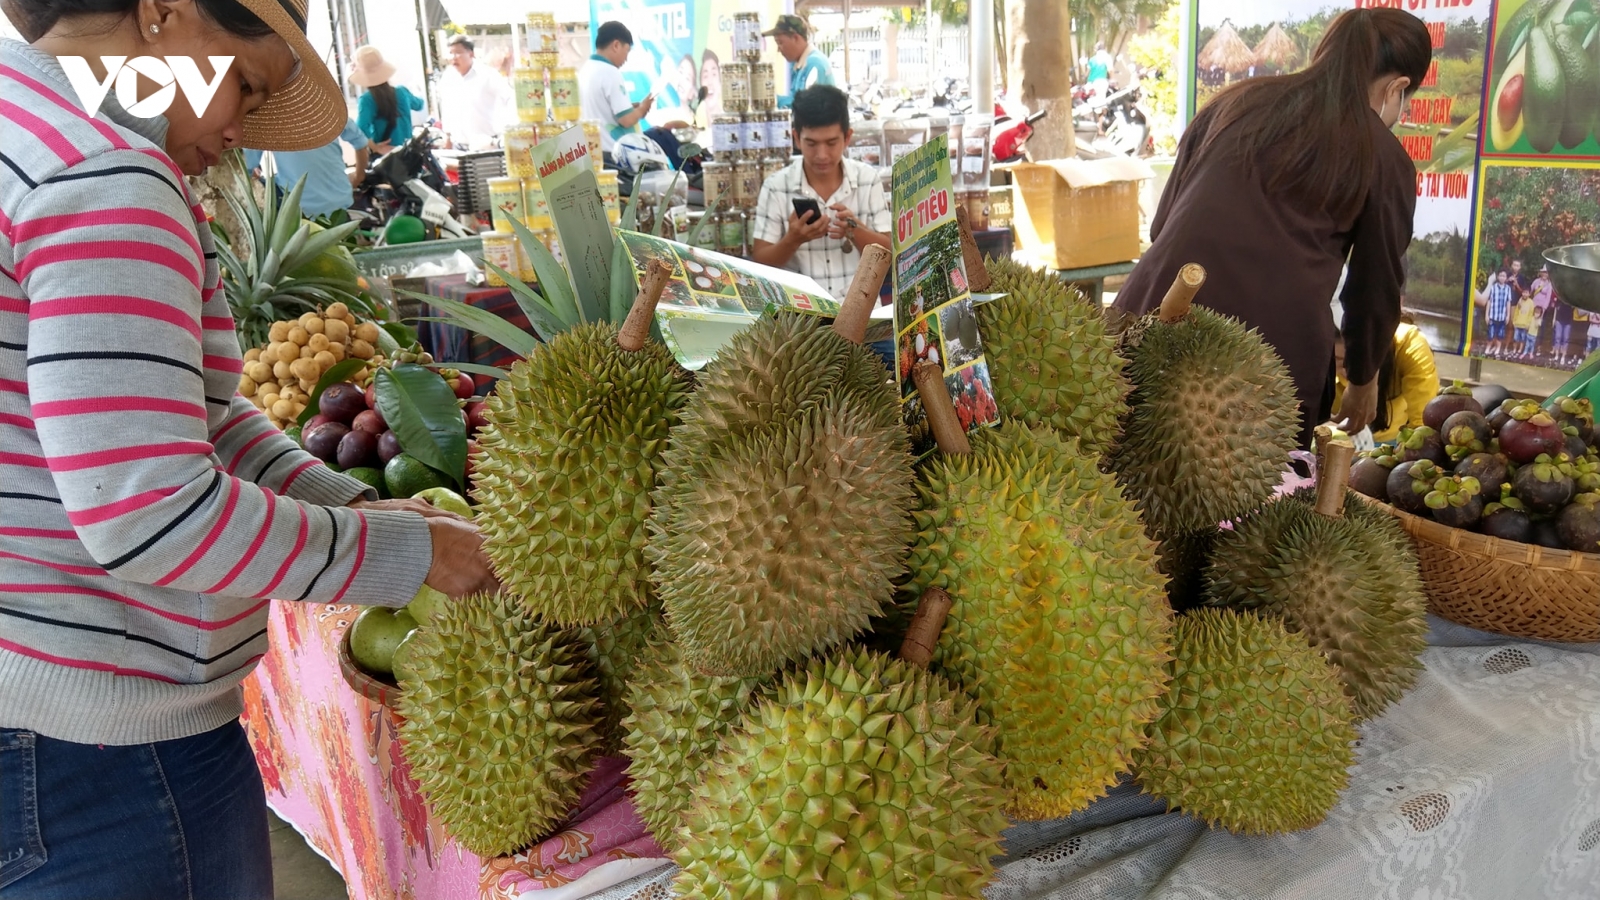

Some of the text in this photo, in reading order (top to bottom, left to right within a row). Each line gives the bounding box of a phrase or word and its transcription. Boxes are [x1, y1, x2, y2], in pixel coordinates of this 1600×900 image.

[1403, 132, 1433, 161] KHÁCH
[1426, 173, 1440, 203] TẠI
[1443, 169, 1469, 199] VƯỜN
[897, 188, 948, 243] ÚT TIÊU
